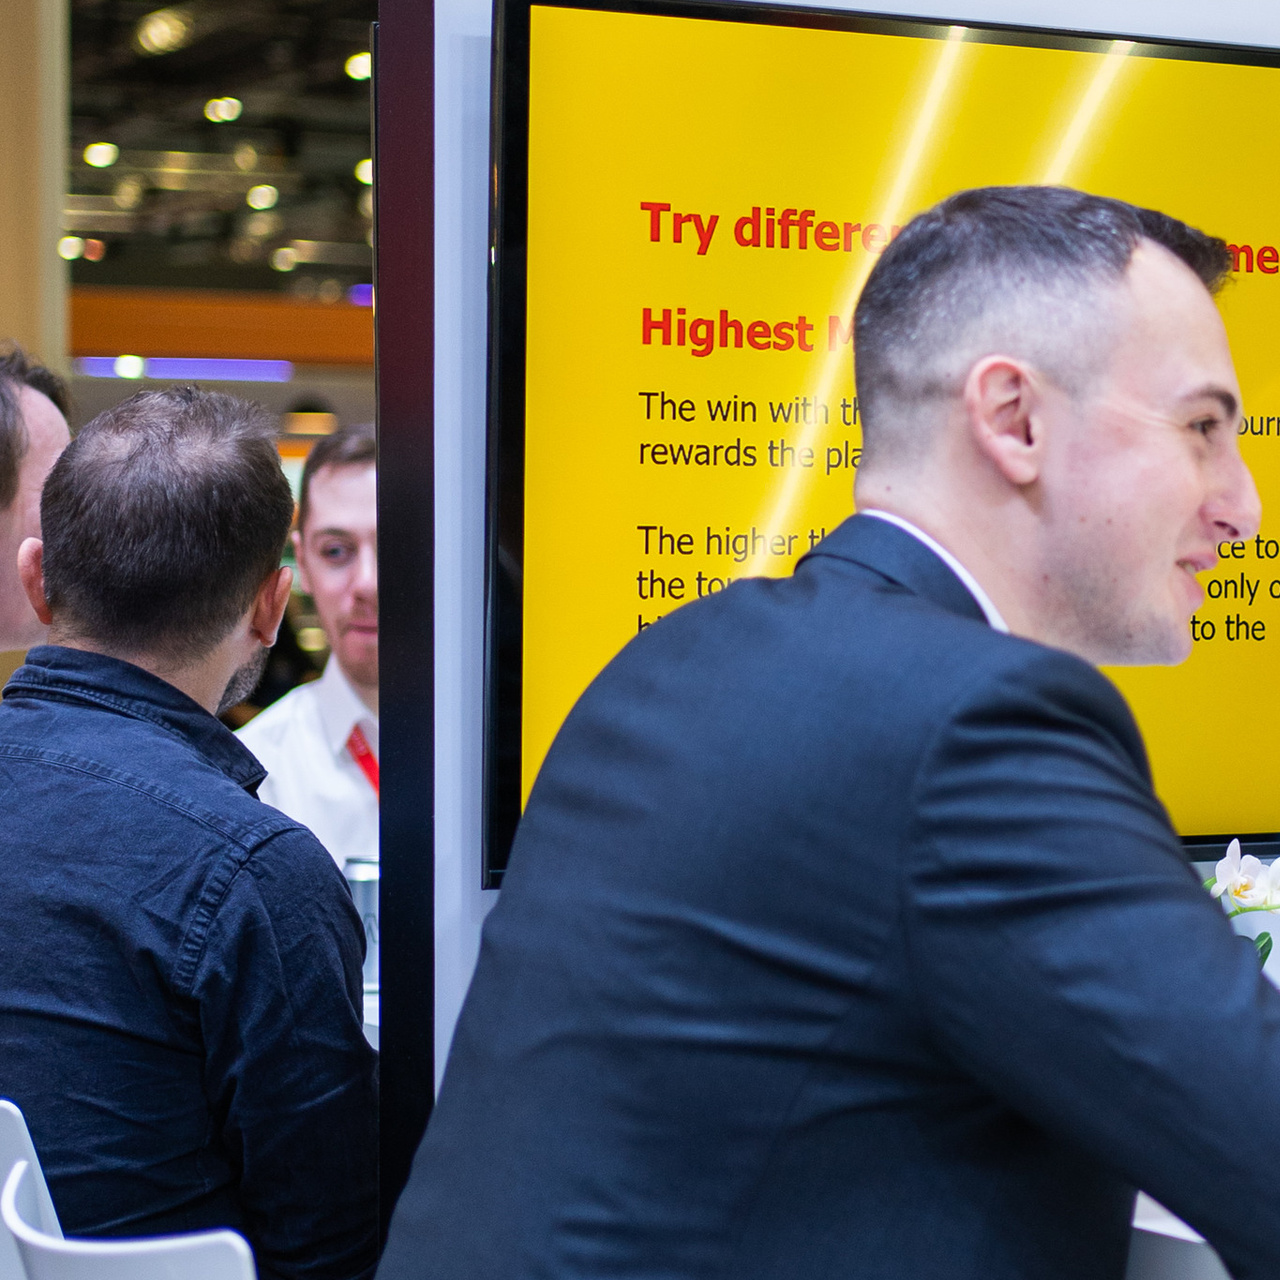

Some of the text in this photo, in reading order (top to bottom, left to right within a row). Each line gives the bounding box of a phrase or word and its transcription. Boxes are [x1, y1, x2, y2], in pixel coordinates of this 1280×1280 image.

[640, 201, 720, 256] Try
[734, 206, 906, 254] differe
[641, 308, 814, 357] Highest
[638, 390, 696, 423] The
[706, 394, 757, 423] win
[768, 396, 829, 425] with
[639, 437, 862, 476] rewards the pla
[637, 525, 694, 555] The
[706, 526, 798, 563] higher
[1217, 540, 1246, 559] ce
[1255, 533, 1280, 559] to
[636, 569, 685, 600] the
[1207, 572, 1260, 606] only
[1190, 614, 1216, 642] to
[1224, 613, 1266, 642] the
